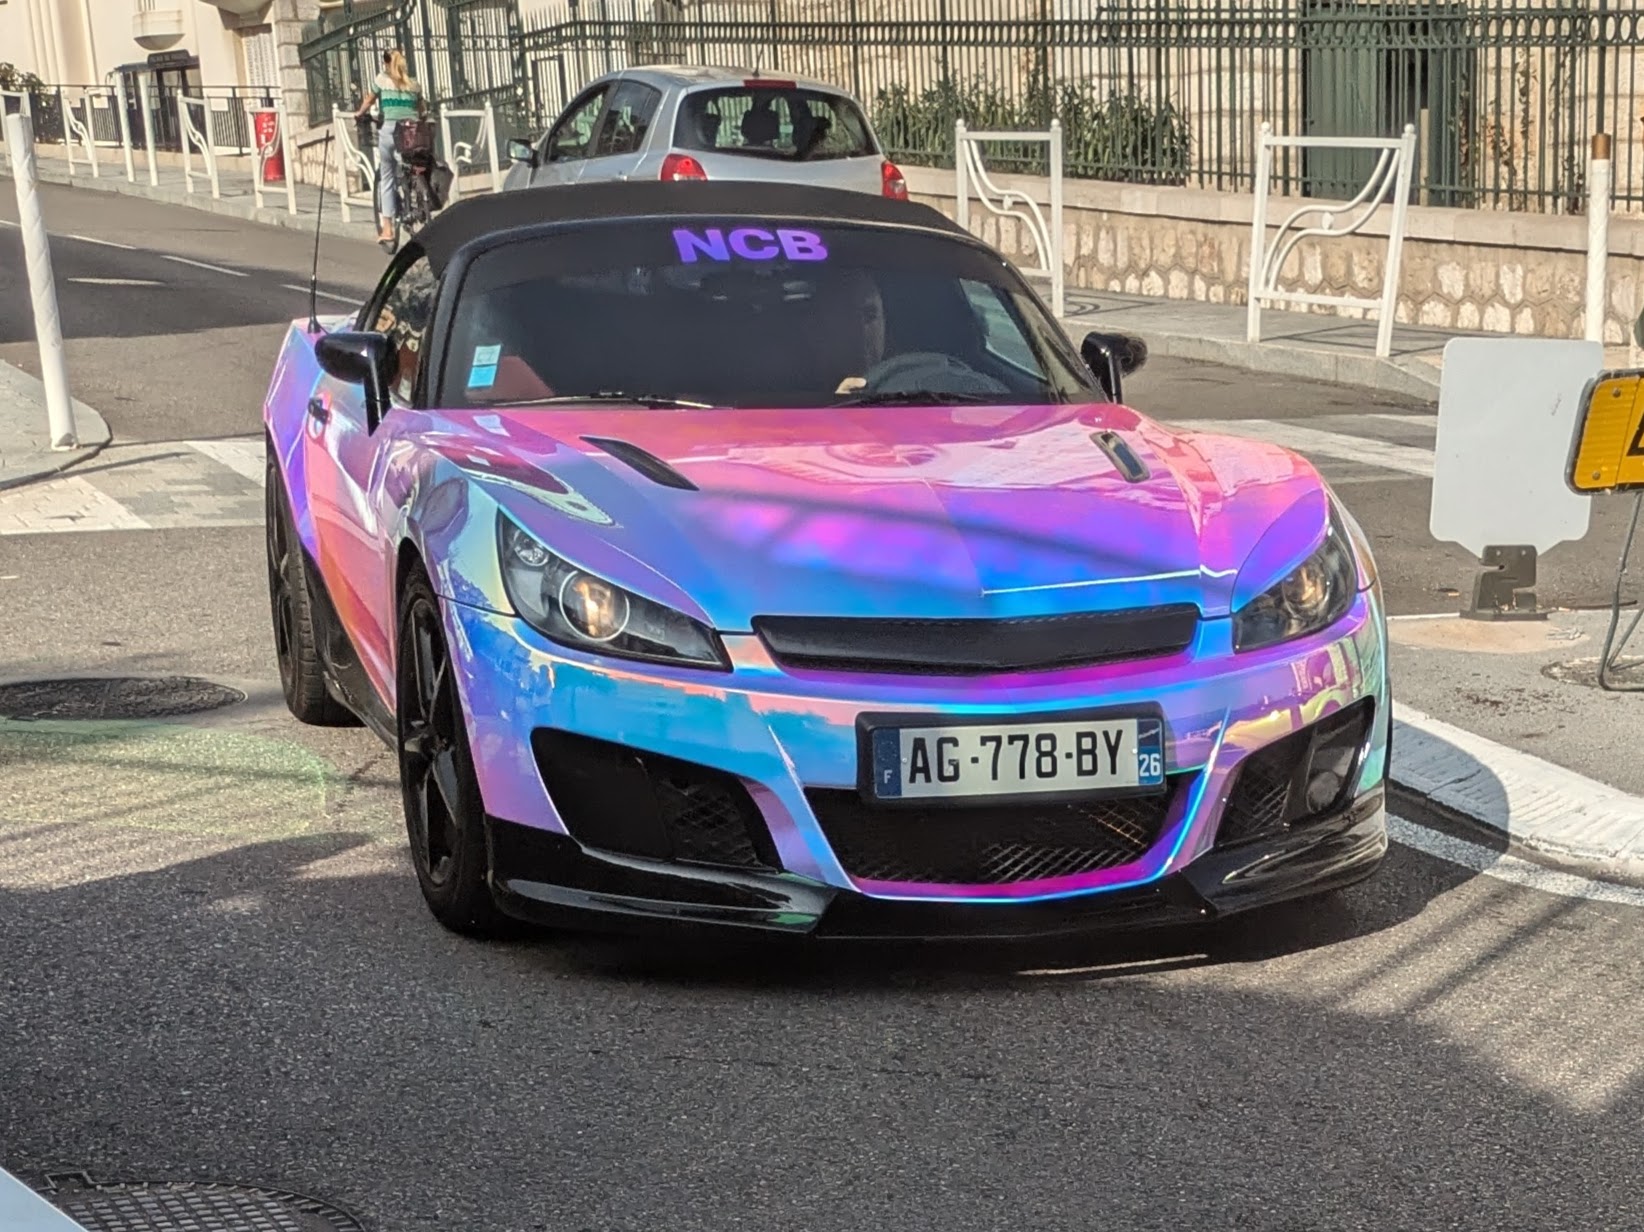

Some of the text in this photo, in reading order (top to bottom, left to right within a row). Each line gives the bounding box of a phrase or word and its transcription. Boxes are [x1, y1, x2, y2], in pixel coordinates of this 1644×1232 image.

[672, 228, 828, 262] NCB
[883, 729, 1161, 784] F AG-778-BY 26
